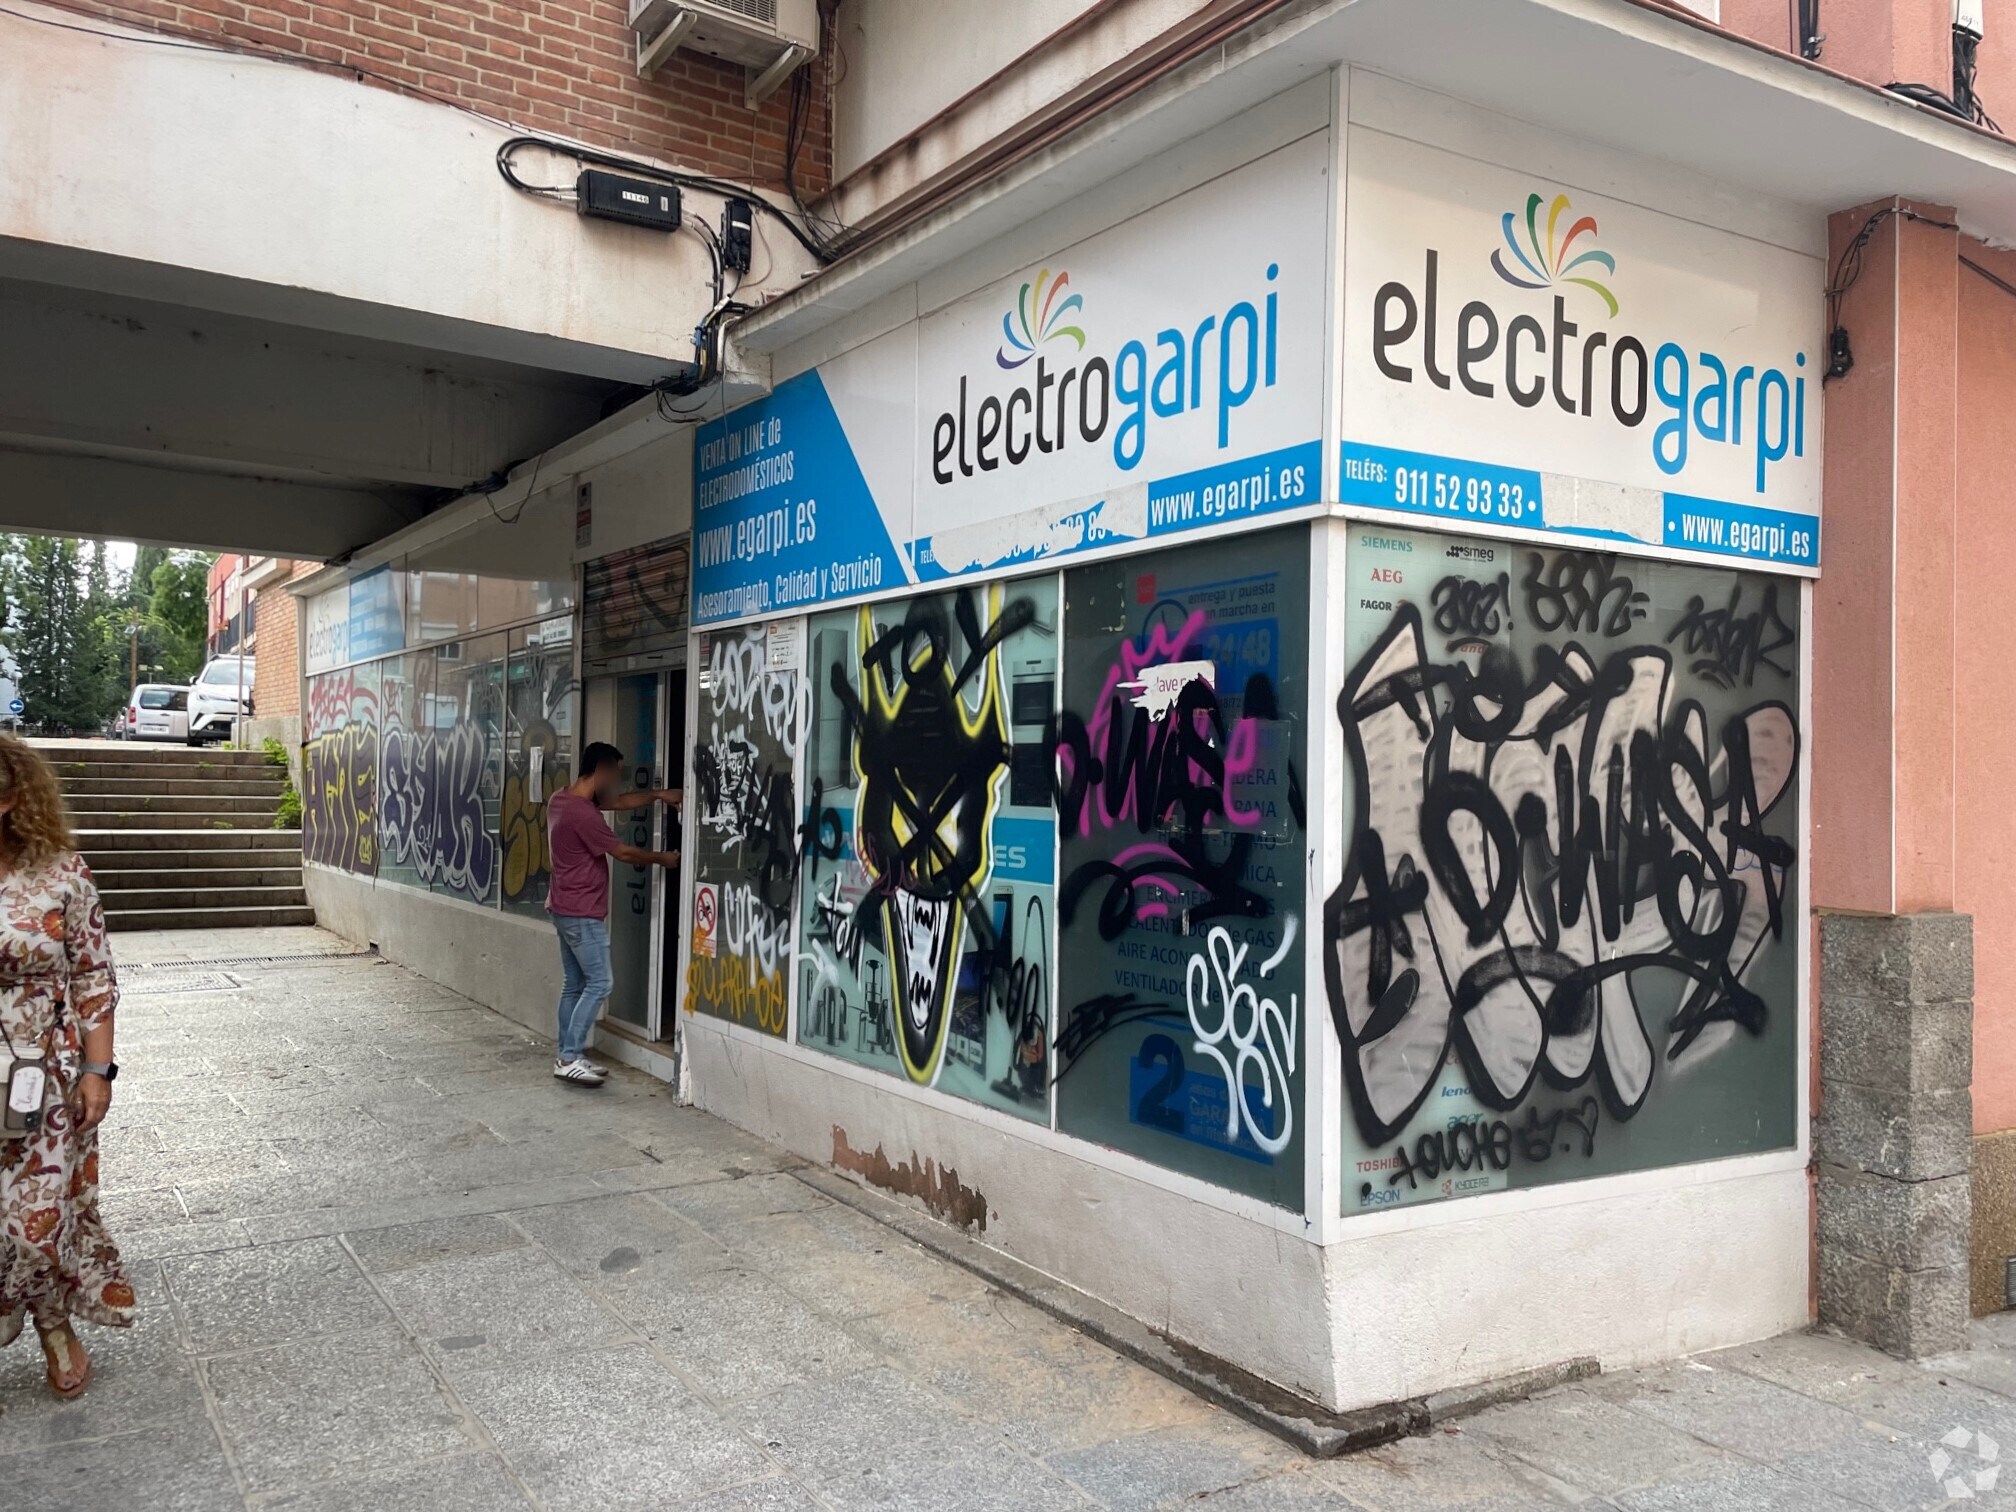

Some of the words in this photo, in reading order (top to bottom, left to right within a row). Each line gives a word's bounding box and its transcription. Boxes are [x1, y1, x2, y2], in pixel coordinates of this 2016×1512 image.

[933, 263, 1279, 485] electrogarpi
[1374, 249, 1805, 493] electrogarpi
[701, 439, 726, 472] VENTA
[729, 431, 741, 461] ON
[744, 420, 765, 456] LINE
[768, 416, 781, 445] de
[701, 450, 794, 509] ELECTRODOMÉSTICOS
[1152, 464, 1305, 527] www.egarpi.es
[1346, 458, 1387, 483] TELÉFS:
[1395, 466, 1428, 506] 911
[1434, 472, 1461, 511] 52
[1466, 477, 1492, 515] 93
[1498, 482, 1523, 519] 33
[699, 499, 816, 568] www.egarpi.es
[1361, 535, 1413, 552] SIEMENS
[1682, 513, 1809, 558] www.egarpi.es
[1464, 547, 1494, 562] smeg
[698, 579, 771, 620] Asesoramiento,
[775, 566, 817, 605] Calidad
[820, 568, 828, 599] y
[831, 552, 882, 594] Servicio
[1370, 568, 1403, 583] AEG
[1188, 589, 1226, 605] entrega
[1229, 589, 1236, 602] y
[1238, 581, 1276, 599] puesta
[1360, 599, 1392, 611] FAGOR
[1219, 603, 1257, 618] marcha
[1261, 601, 1275, 613] en
[1118, 941, 1147, 960] AIRE
[1244, 927, 1276, 949] GAS
[1115, 969, 1199, 1001] VENTILADOR
[1137, 1033, 1185, 1134] 2
[1357, 1158, 1403, 1173] TOSHIB
[1360, 1188, 1400, 1207] EPSON
